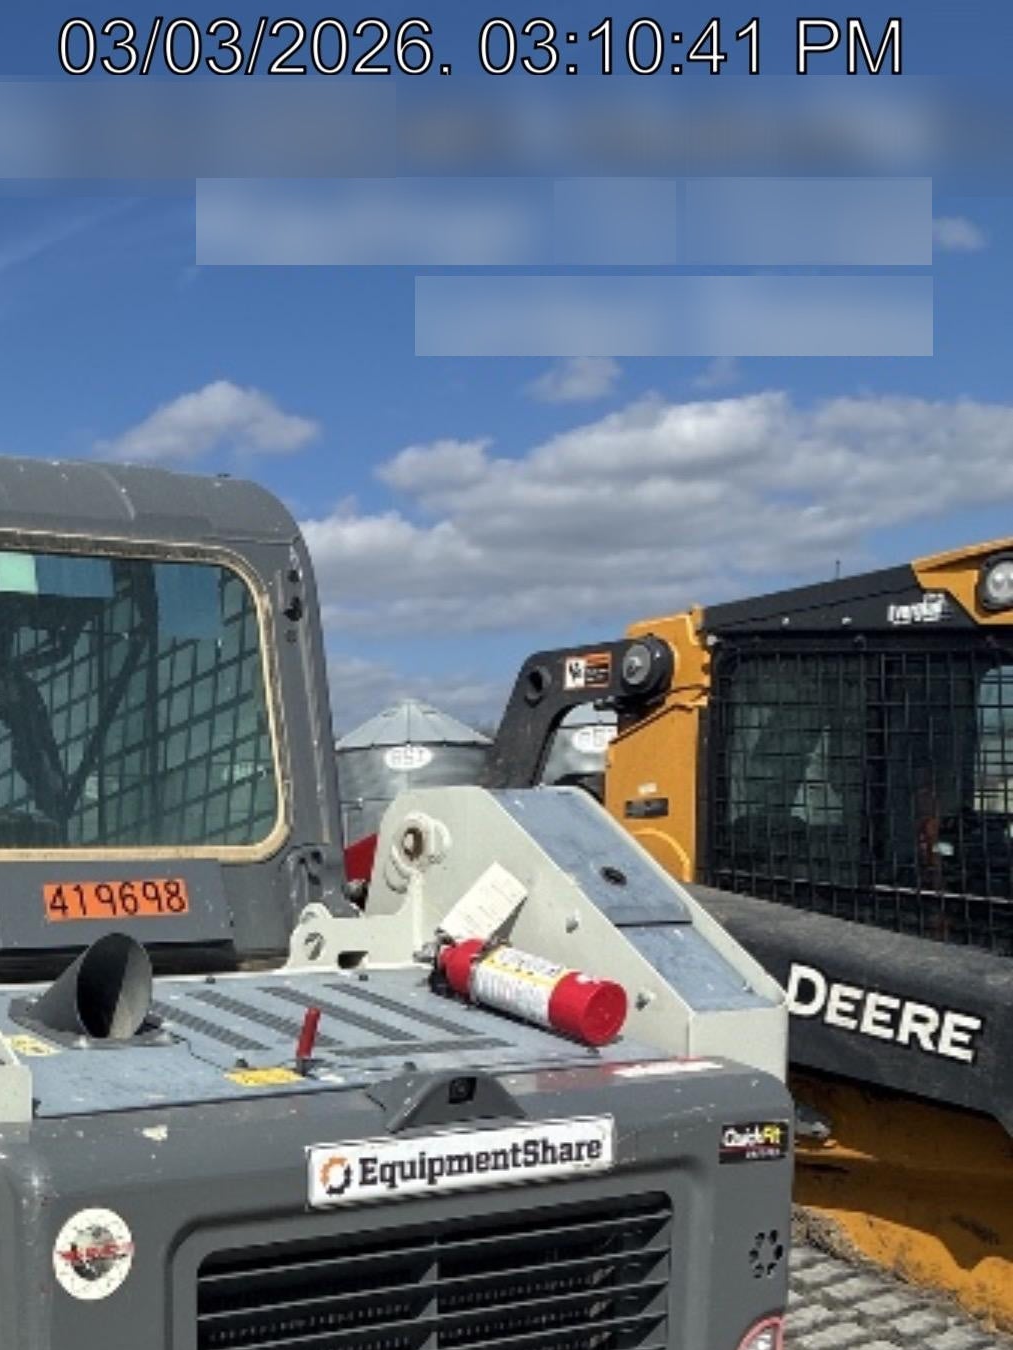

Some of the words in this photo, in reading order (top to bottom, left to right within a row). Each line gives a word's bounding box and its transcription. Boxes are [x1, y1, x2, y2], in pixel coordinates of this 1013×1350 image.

[49, 880, 186, 916] 419698
[788, 961, 982, 1063] DEERE
[357, 1137, 602, 1189] EquipmentShare
